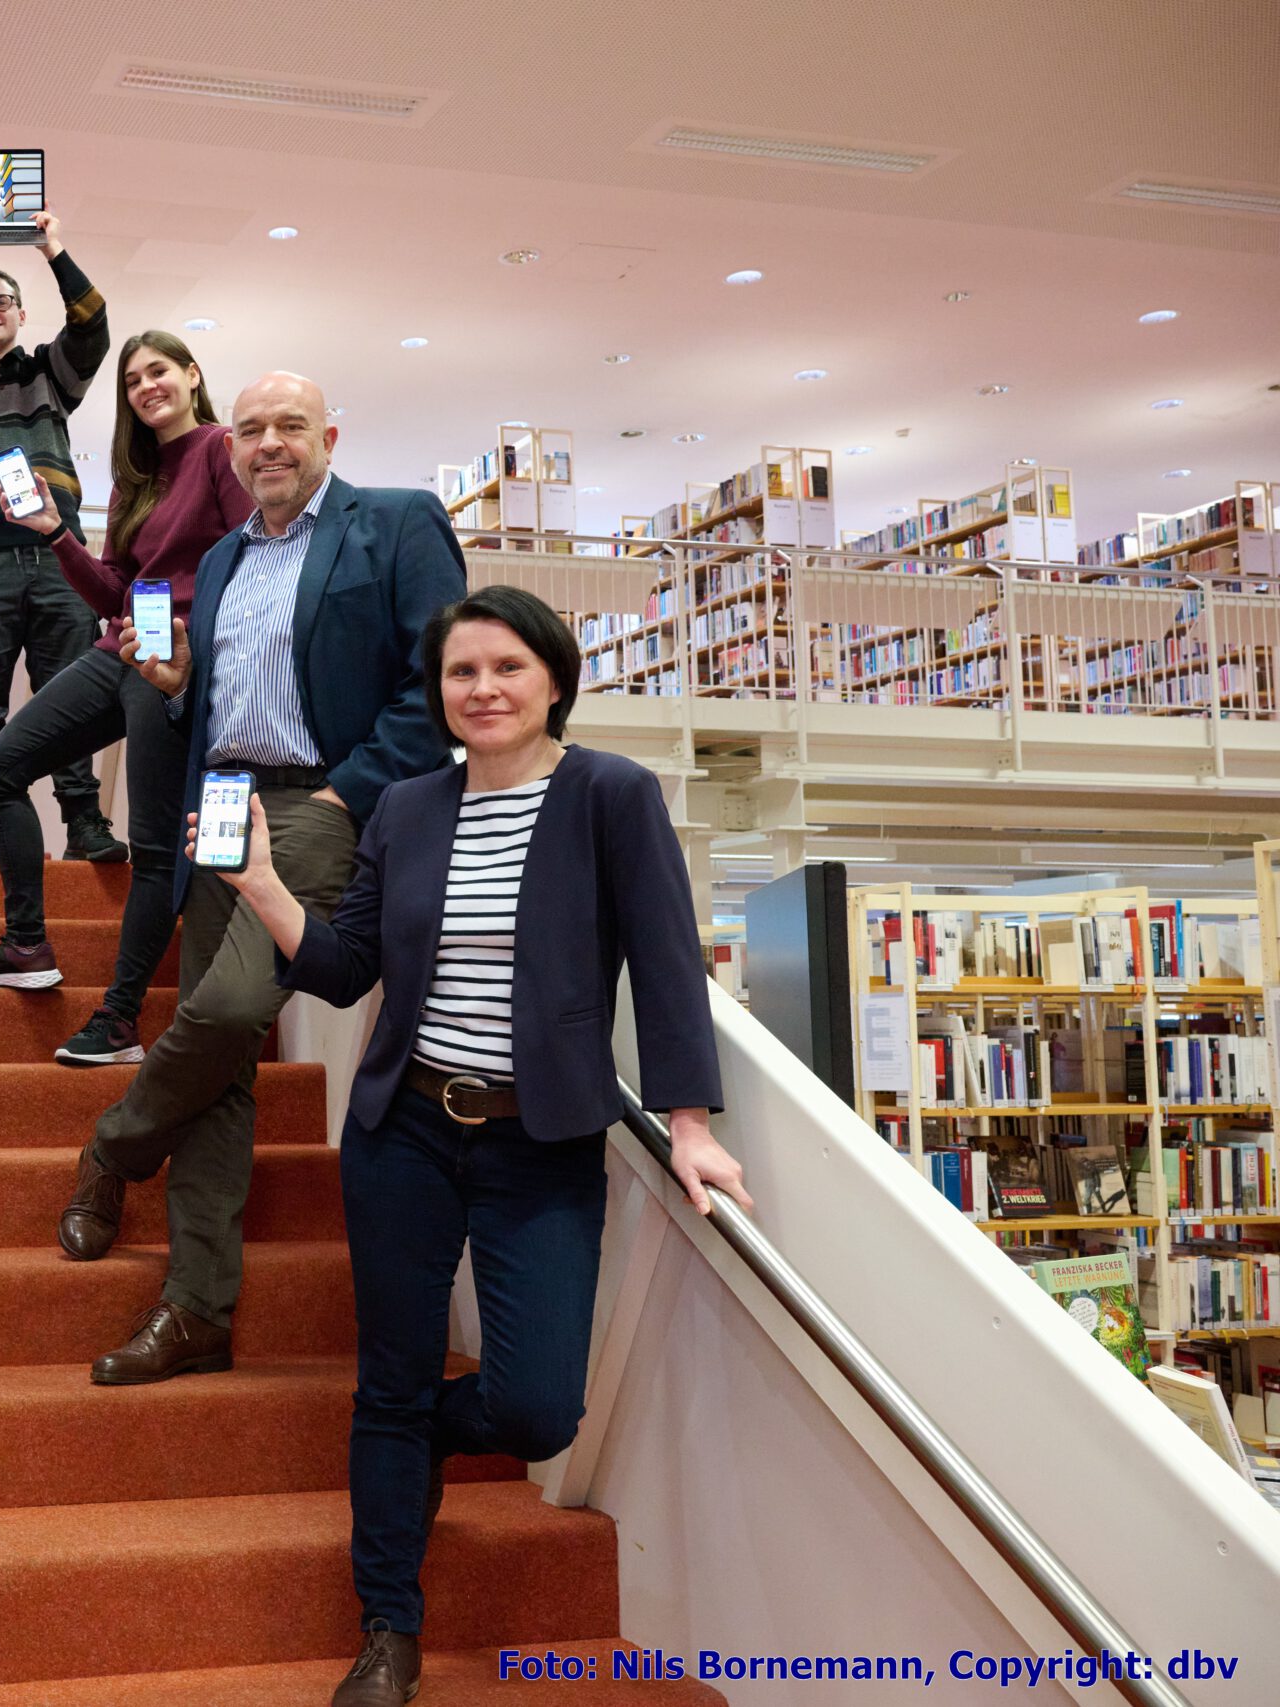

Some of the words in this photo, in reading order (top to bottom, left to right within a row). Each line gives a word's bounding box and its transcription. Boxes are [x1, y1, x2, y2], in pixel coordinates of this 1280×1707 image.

[1009, 1194, 1047, 1204] WELTKRIEG
[1052, 1264, 1093, 1276] FRANZISKA
[1095, 1261, 1123, 1272] BECKER
[1054, 1275, 1081, 1288] LETZTE
[1084, 1270, 1125, 1285] WARNUNG
